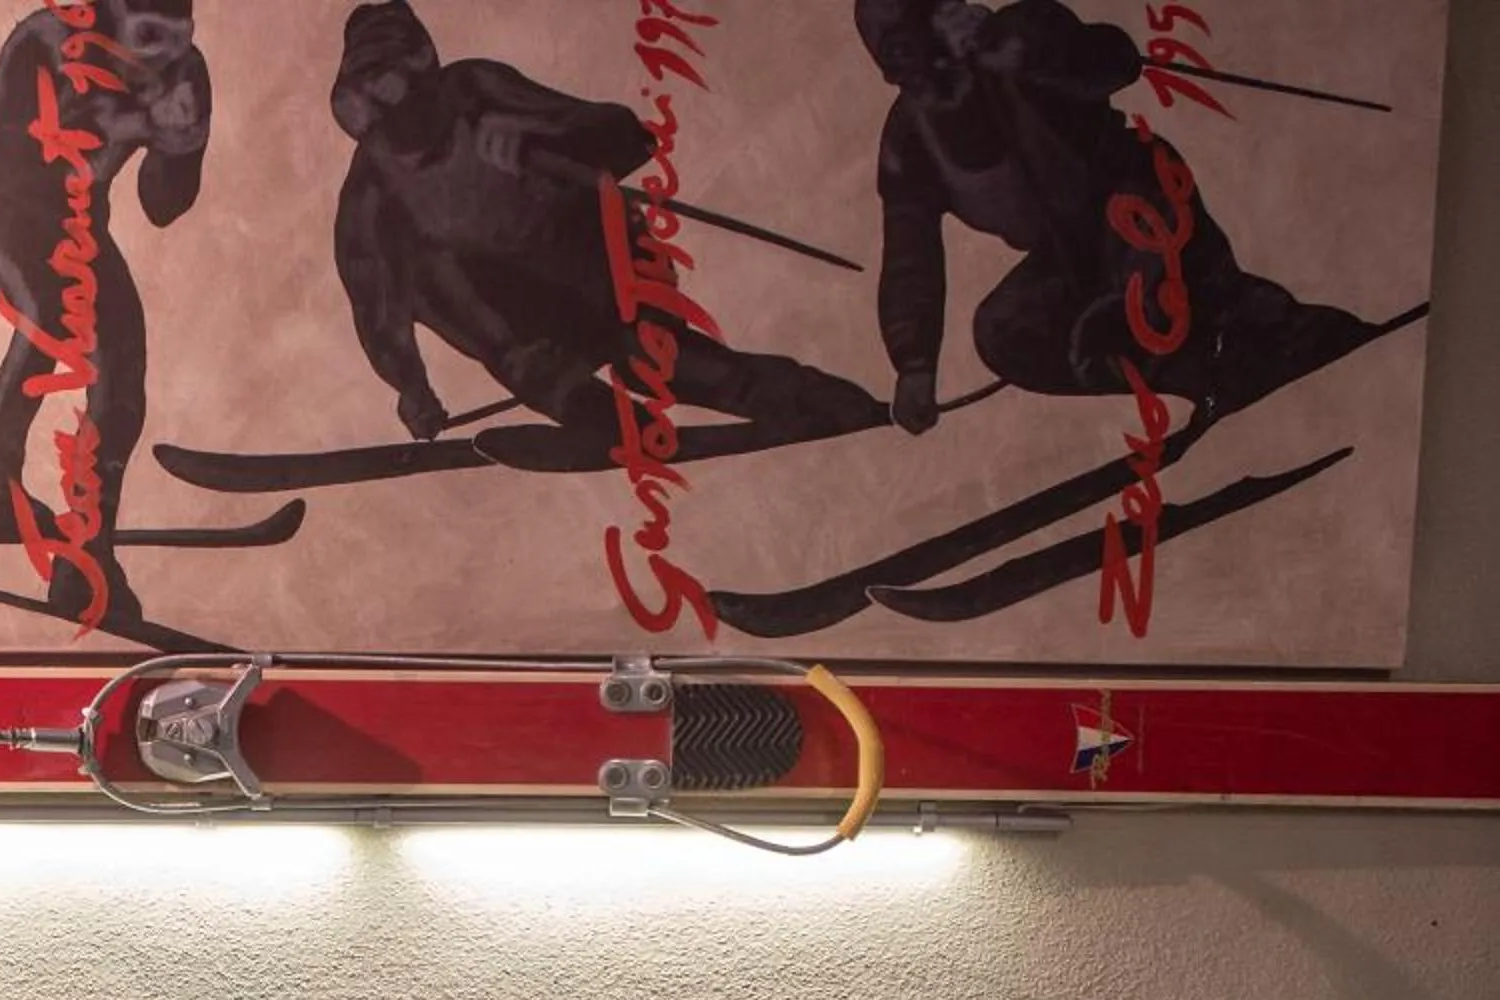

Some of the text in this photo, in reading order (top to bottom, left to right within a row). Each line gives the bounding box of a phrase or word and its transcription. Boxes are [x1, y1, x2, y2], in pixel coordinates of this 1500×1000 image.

[10, 408, 108, 641] Jean
[604, 318, 719, 642] Gustavo
[1100, 356, 1170, 639] Zeno
